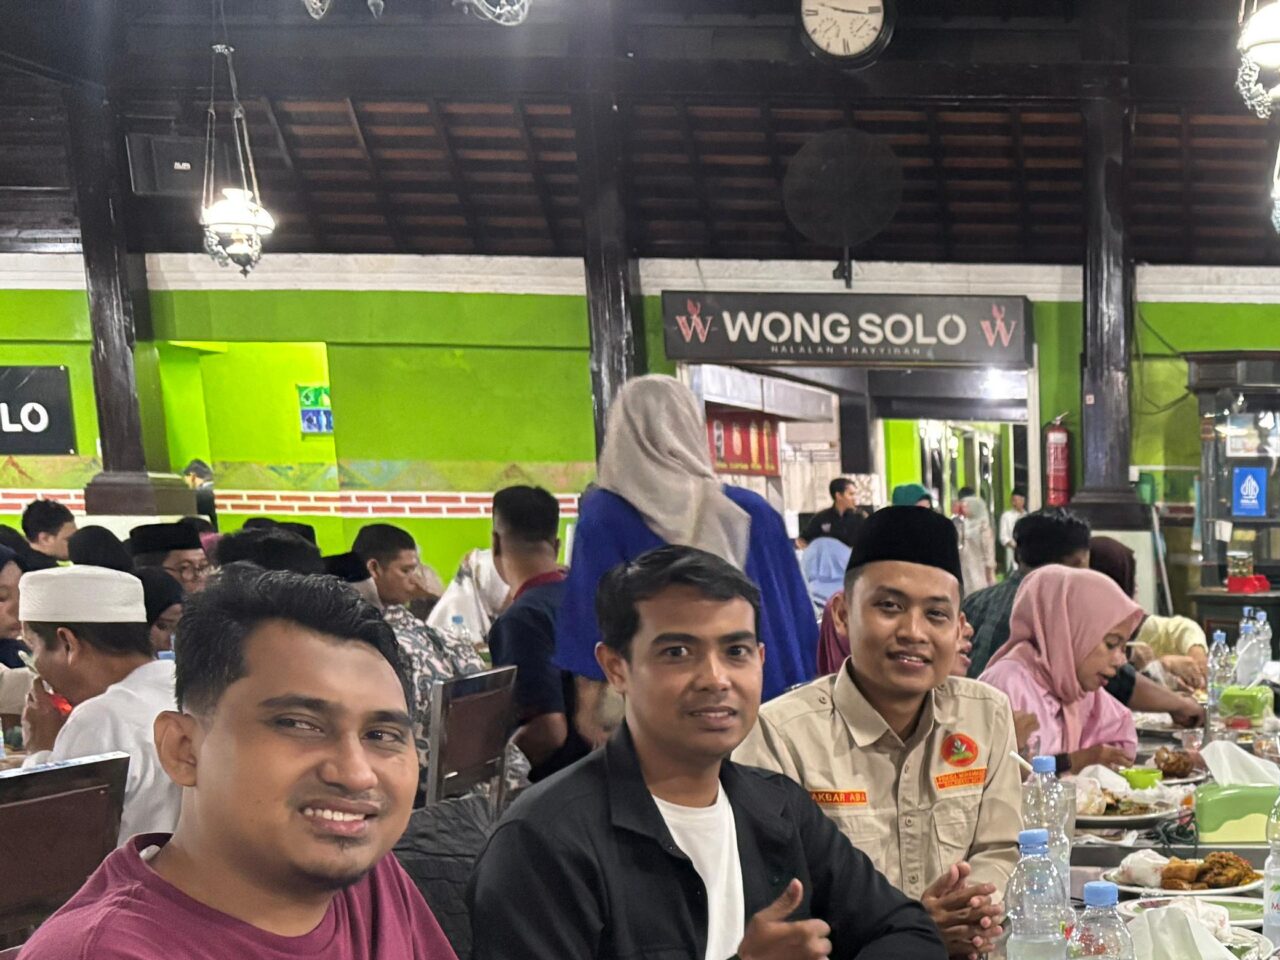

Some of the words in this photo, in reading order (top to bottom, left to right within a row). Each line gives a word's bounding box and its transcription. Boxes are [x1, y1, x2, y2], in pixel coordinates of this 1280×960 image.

[722, 310, 851, 345] WONG
[858, 313, 968, 346] SOLO
[0, 402, 49, 433] LO
